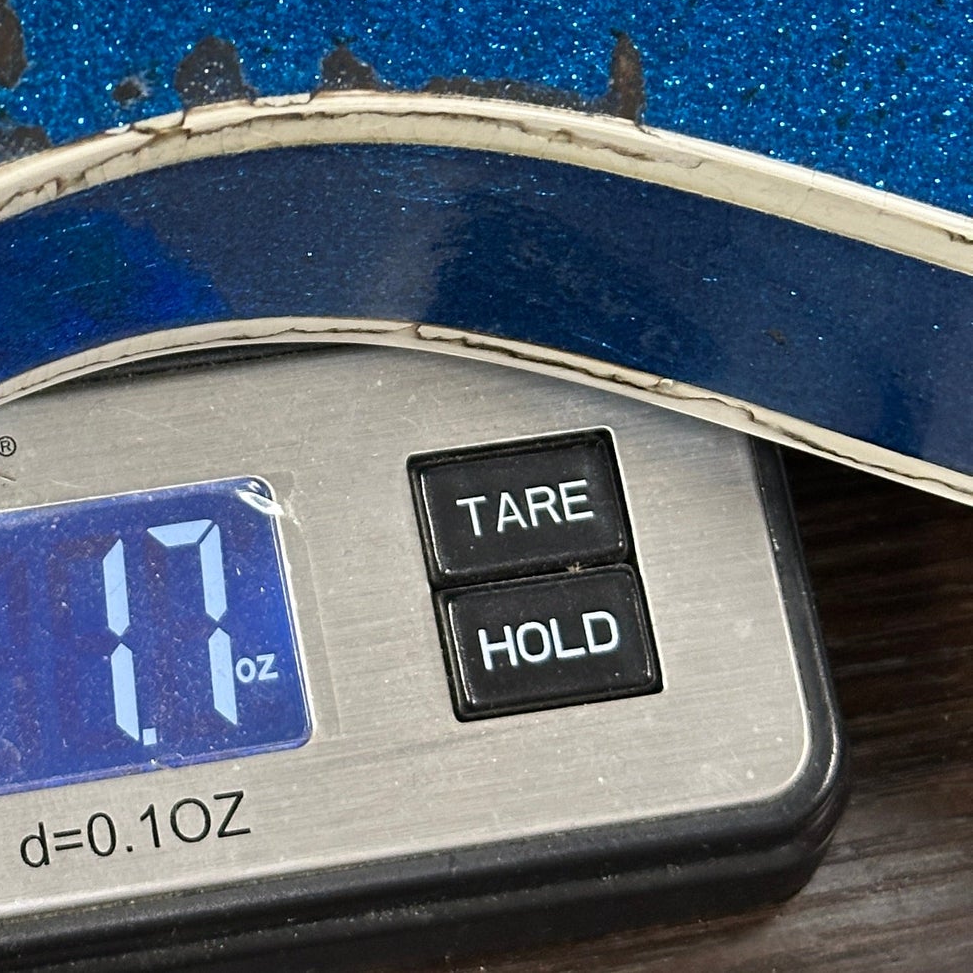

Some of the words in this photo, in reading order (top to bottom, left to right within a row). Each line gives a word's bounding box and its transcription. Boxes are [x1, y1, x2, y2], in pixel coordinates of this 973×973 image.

[455, 479, 594, 537] TARE
[103, 519, 237, 745] 1.7
[477, 610, 619, 671] HOLD
[20, 790, 251, 869] d=0.1OZ
